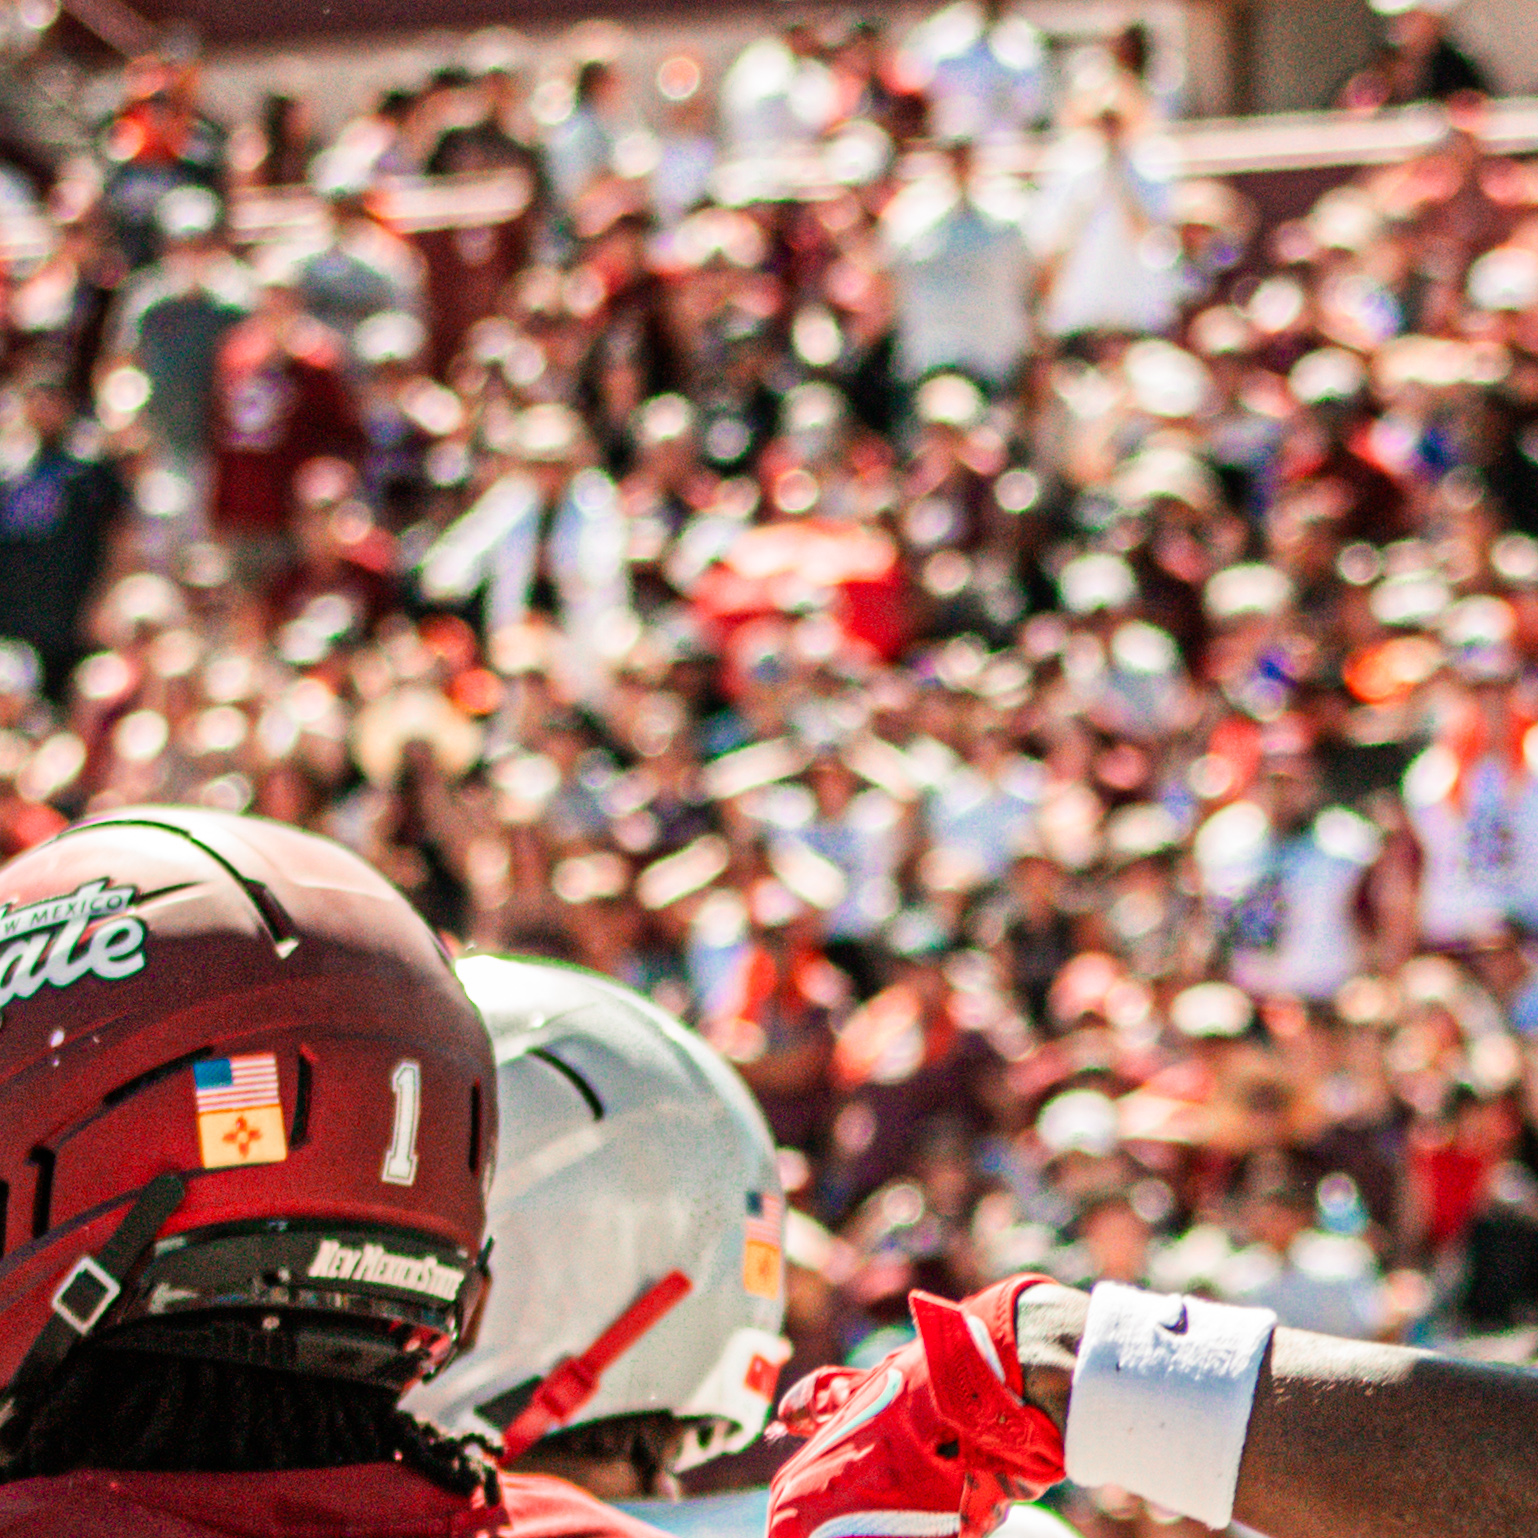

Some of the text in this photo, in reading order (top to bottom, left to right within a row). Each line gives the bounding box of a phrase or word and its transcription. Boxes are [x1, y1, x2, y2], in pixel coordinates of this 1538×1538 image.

[0, 876, 147, 1009] ate
[30, 895, 123, 927] MEXICO
[382, 1060, 421, 1187] 1
